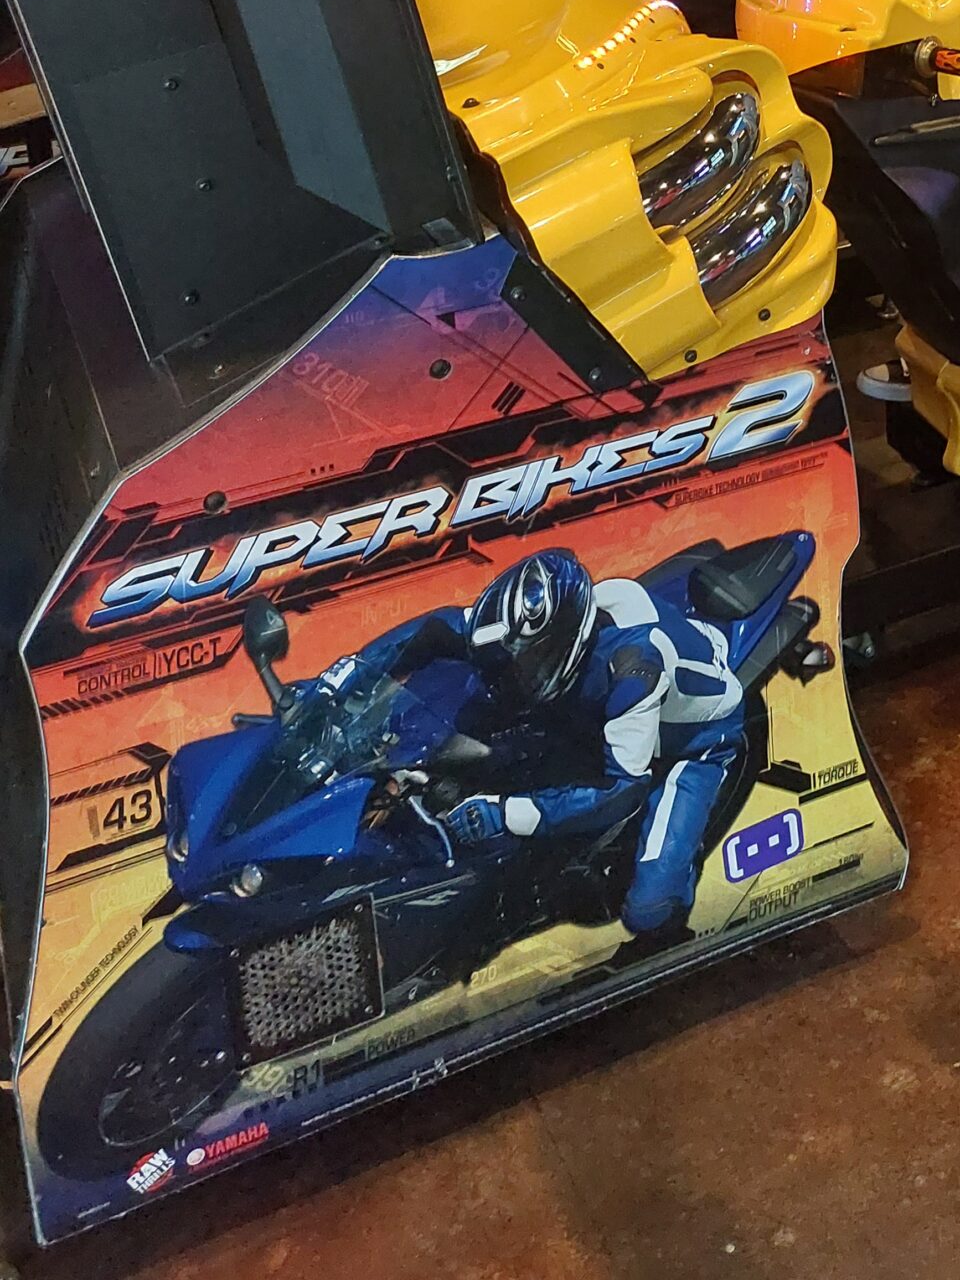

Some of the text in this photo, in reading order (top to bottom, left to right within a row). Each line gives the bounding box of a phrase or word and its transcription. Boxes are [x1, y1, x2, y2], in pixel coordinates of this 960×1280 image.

[86, 370, 815, 628] SUPER BIKES 2
[714, 470, 761, 495] TECHNOLOGY
[78, 662, 149, 696] CONTROL
[162, 636, 221, 674] YCC-T
[818, 761, 859, 788] TORQUE
[102, 788, 153, 831] 43
[749, 890, 801, 922] OUTPUT
[750, 876, 811, 909] POWER BOOST
[98, 924, 140, 971] TECHNOLOGY
[205, 1121, 270, 1159] YAMAHA
[126, 1147, 169, 1191] RAW
[135, 1156, 177, 1195] THRILLS
